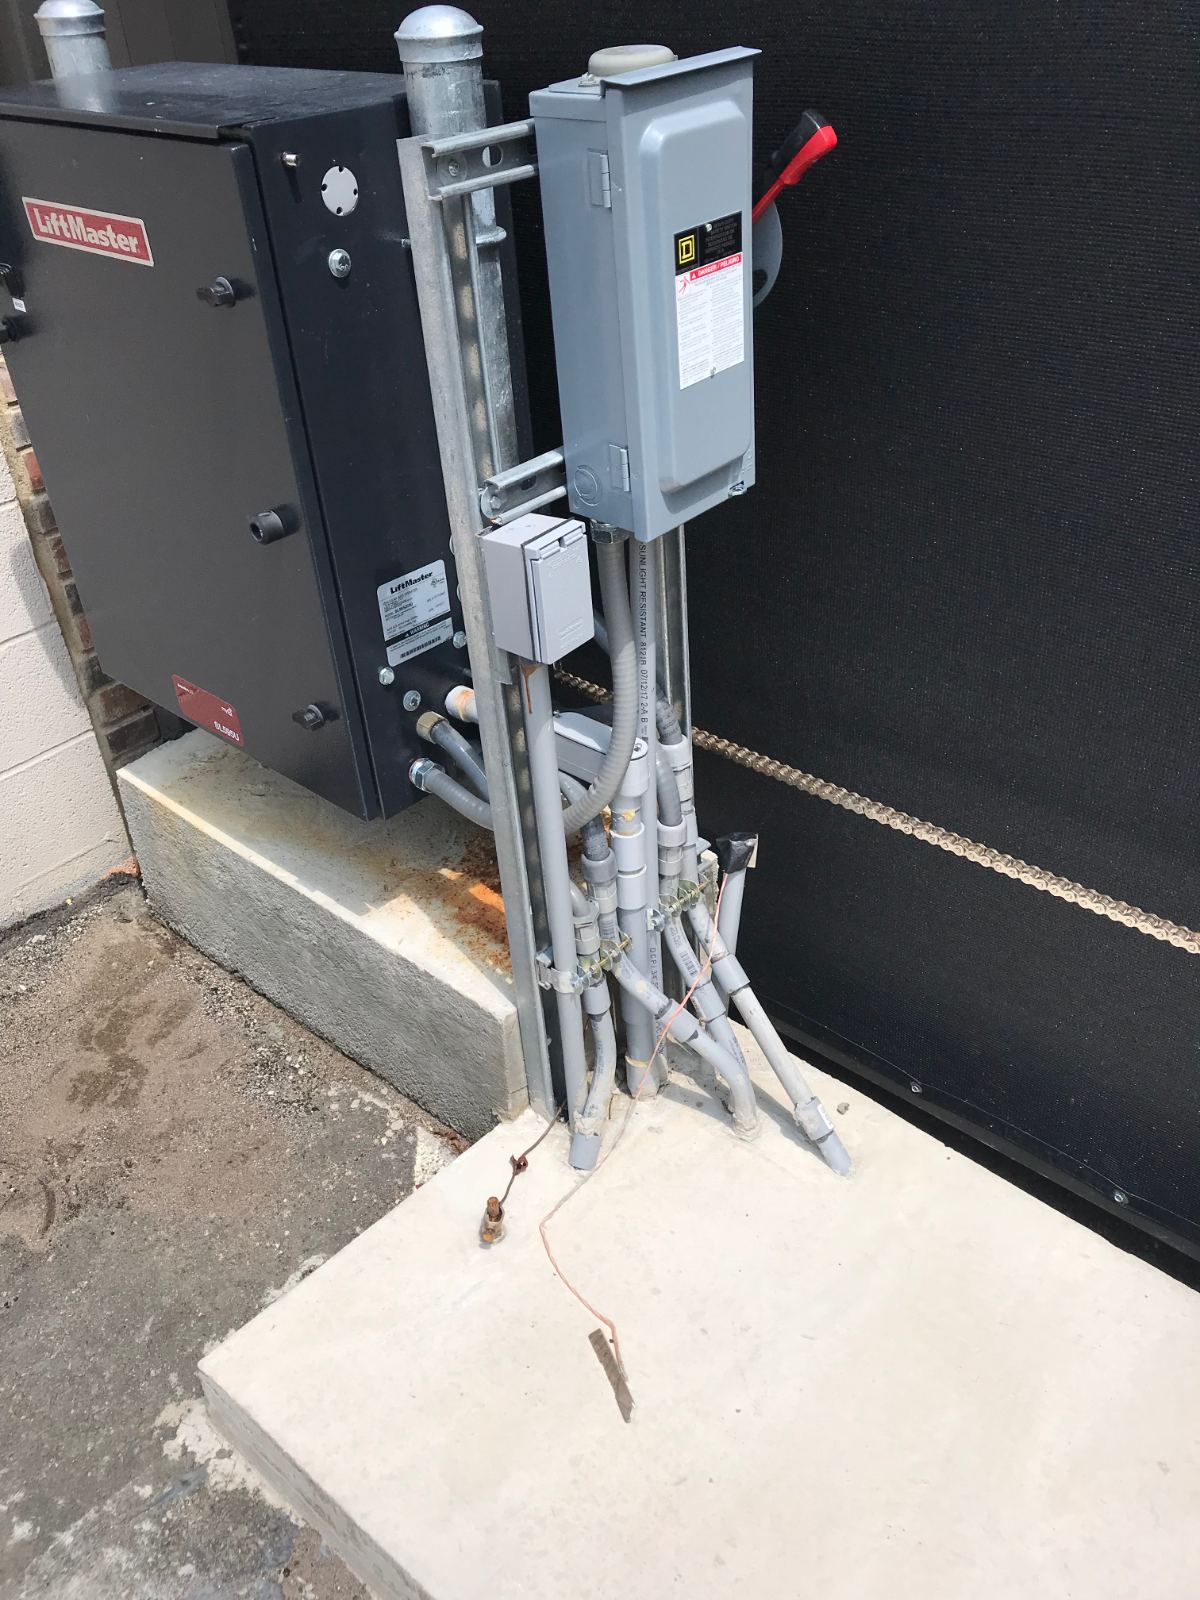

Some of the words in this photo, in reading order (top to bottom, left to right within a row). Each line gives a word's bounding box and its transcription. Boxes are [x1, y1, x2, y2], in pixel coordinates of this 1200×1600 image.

[33, 207, 139, 253] LiftMaster
[390, 572, 433, 594] LiftMaster
[639, 543, 647, 590] SUNLIGHT
[410, 622, 430, 636] WARNING
[639, 591, 647, 639] RESISTANT
